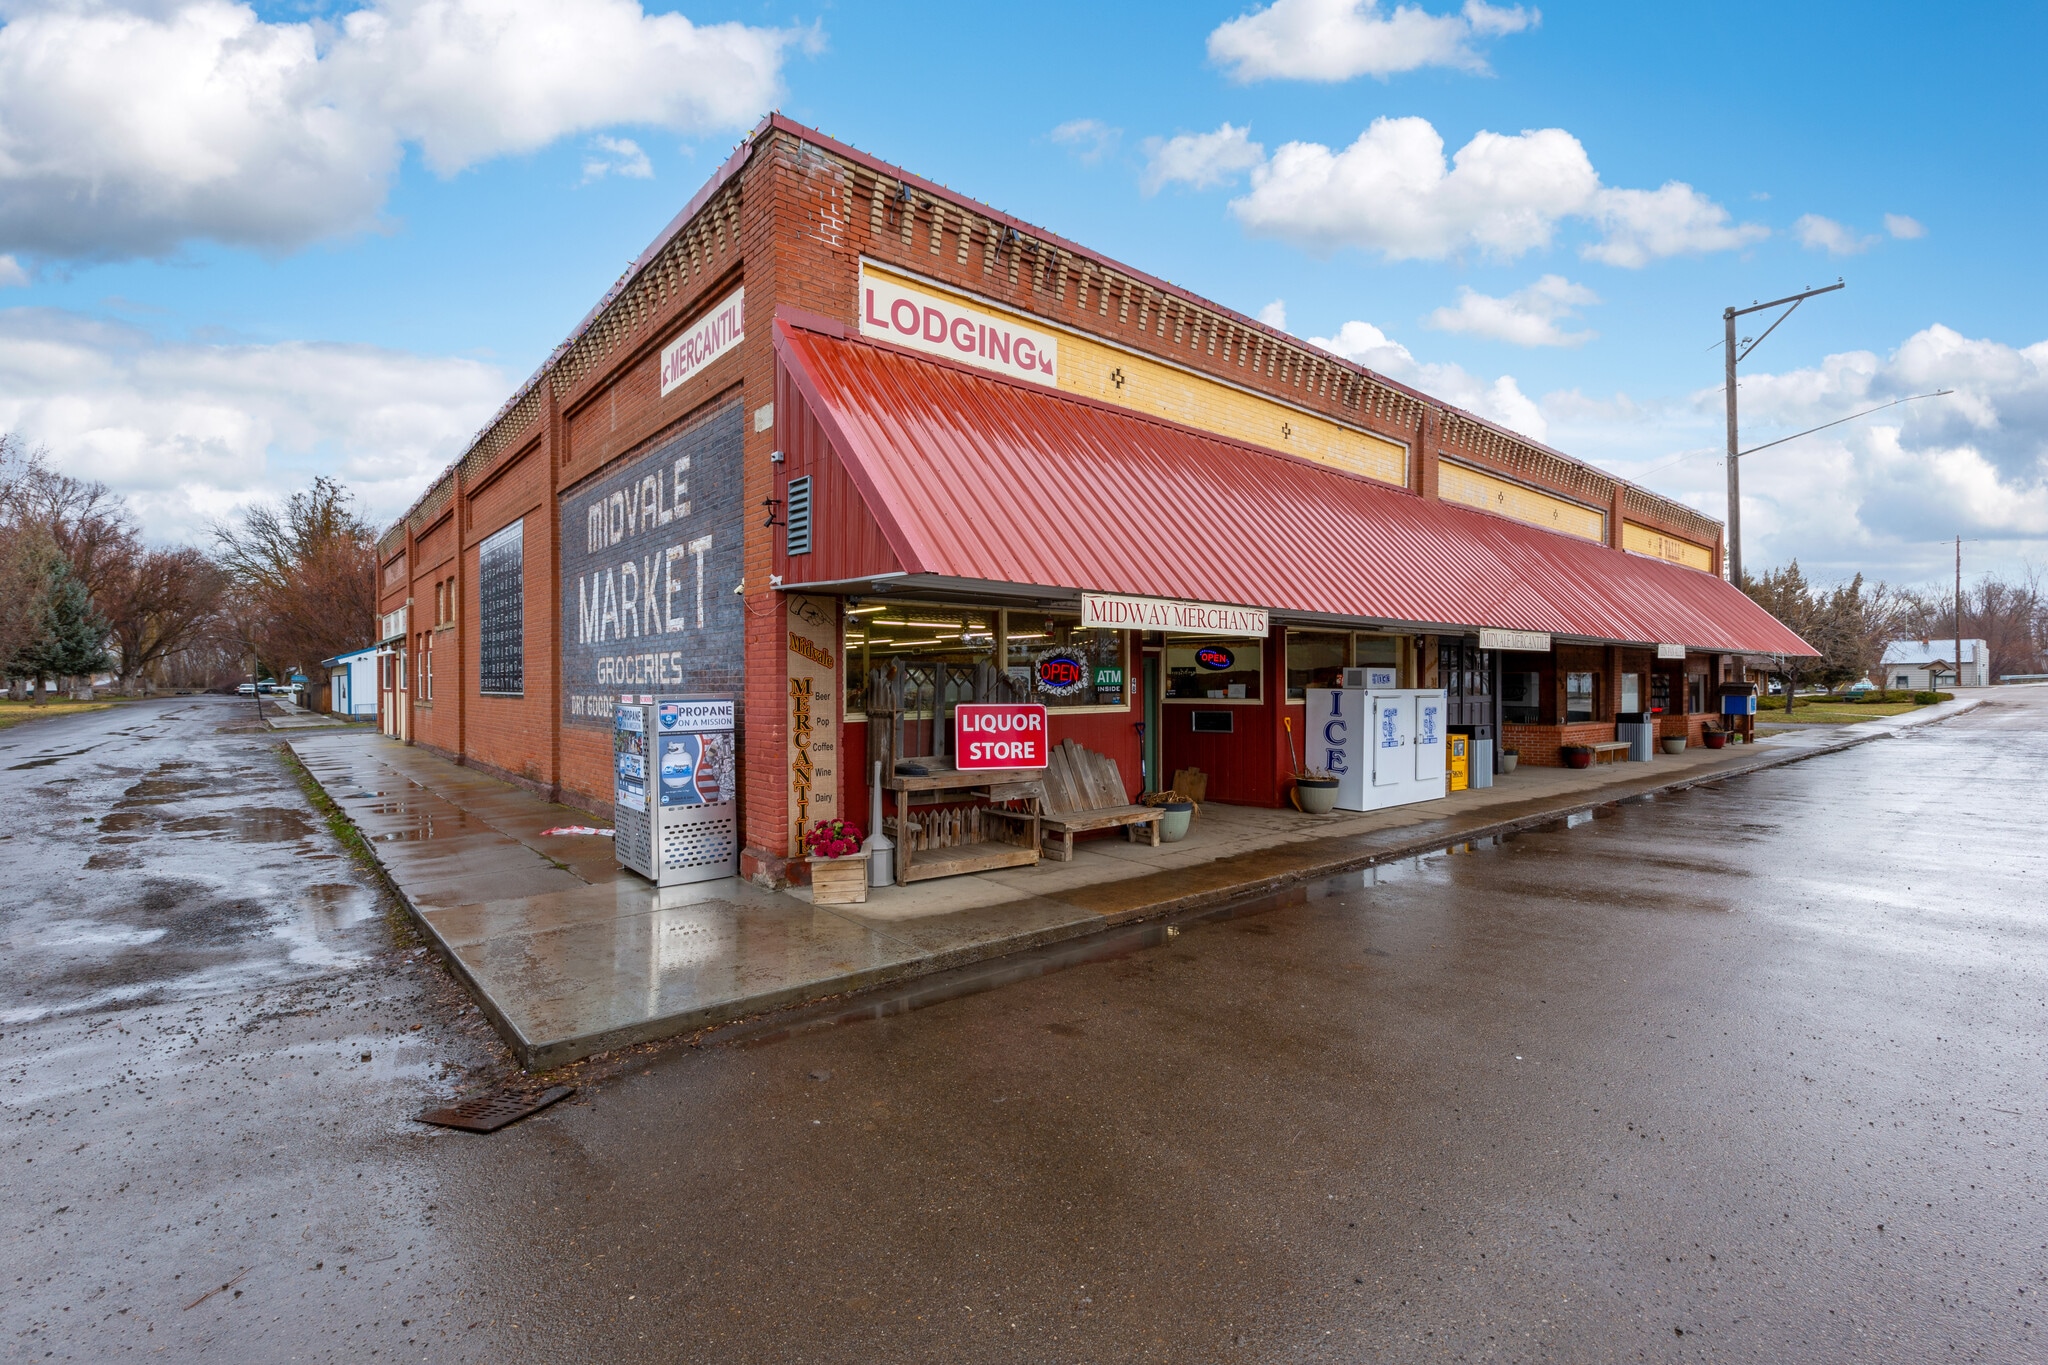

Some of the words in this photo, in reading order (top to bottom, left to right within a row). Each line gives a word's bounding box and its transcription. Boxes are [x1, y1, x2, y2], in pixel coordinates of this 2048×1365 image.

[865, 288, 1037, 371] LODGING
[586, 455, 691, 554] MIDVALE
[578, 534, 714, 646] MARKET
[1090, 599, 1170, 626] MIDWAY
[1174, 606, 1264, 632] MERCHANTS
[1481, 632, 1510, 648] MIDVALE
[1511, 634, 1549, 650] MERCANTILE
[789, 632, 834, 669] Midvale
[1201, 653, 1226, 663] OPEN
[597, 651, 682, 685] GROCERIES
[1041, 662, 1079, 682] OPEN
[1097, 670, 1121, 683] ATM
[815, 691, 831, 701] Beer
[571, 695, 584, 716] DRY
[587, 695, 614, 718] GOODS
[622, 709, 641, 722] PROPANE
[678, 705, 733, 717] PROPANE
[678, 719, 690, 727] ON
[700, 717, 733, 726] MISSION
[816, 717, 830, 728] Pop
[962, 713, 1041, 733] LIQUOR
[1323, 690, 1349, 775] ICE
[812, 742, 834, 752] Coffee
[969, 741, 1036, 760] STORE
[815, 768, 832, 777] Wine
[815, 793, 832, 803] Dairy
